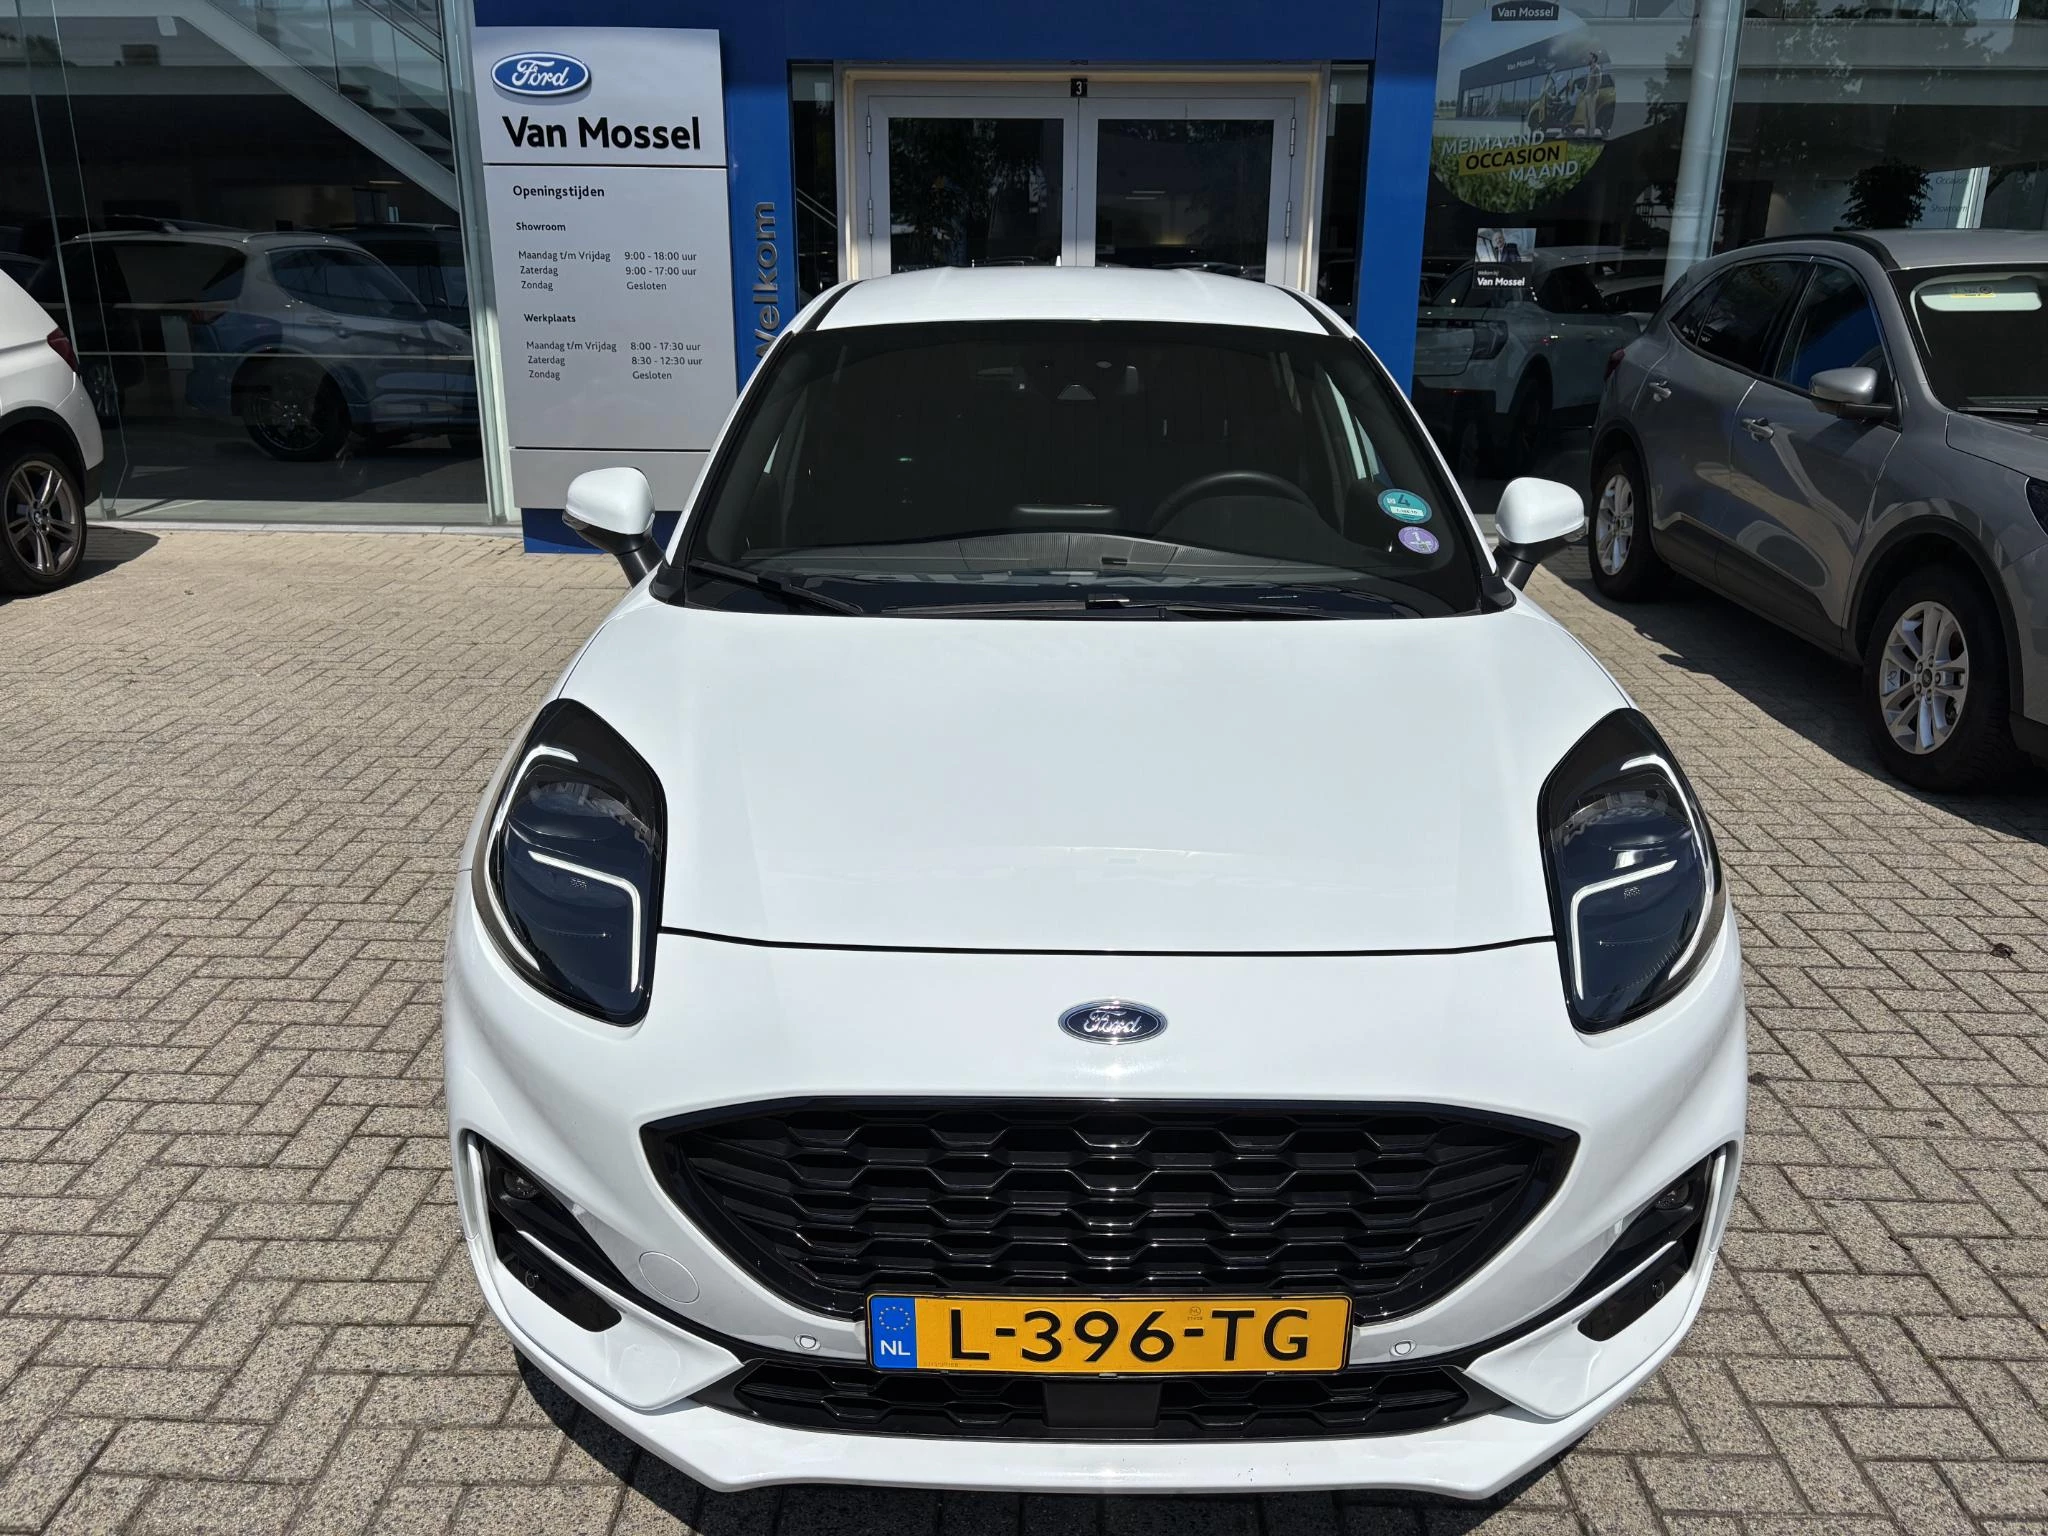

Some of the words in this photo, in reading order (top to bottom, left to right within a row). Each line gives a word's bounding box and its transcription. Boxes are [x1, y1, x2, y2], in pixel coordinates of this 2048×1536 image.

[1497, 7, 1516, 17] Van
[1519, 6, 1554, 17] Mossel
[511, 59, 570, 86] Ford
[1075, 80, 1083, 95] 3
[502, 115, 567, 148] Van
[578, 116, 700, 150] Mossel
[1442, 131, 1545, 156] MEIMAAND
[1465, 145, 1560, 170] OCCASION
[1508, 160, 1578, 182] MAAND
[512, 185, 605, 200] Openingstijden
[515, 221, 566, 232] Showroom
[518, 250, 558, 262] Maandag
[559, 251, 577, 260] t/m
[579, 251, 611, 262] Vrijdag
[624, 251, 645, 261] 9:00
[654, 252, 680, 261] 18:00
[681, 253, 697, 261] uur
[519, 265, 559, 277] Zaterdag
[625, 267, 646, 276] 9:00
[655, 267, 680, 276] 17:00
[681, 268, 697, 276] uur
[521, 280, 553, 291] Zondag
[626, 281, 667, 290] Gesloten
[1477, 277, 1493, 286] Van
[1495, 277, 1525, 286] Mossel
[523, 313, 576, 325] Werkplaats
[526, 341, 565, 352] Maandag
[566, 341, 583, 350] t/m
[585, 341, 617, 353] Vrijdag
[630, 342, 651, 351] 8:00
[659, 342, 684, 351] 17:30
[685, 343, 701, 351] uur
[527, 355, 565, 366] Zaterdag
[631, 356, 652, 365] 8:30
[660, 356, 685, 366] 12:30
[687, 358, 702, 366] uur
[528, 370, 560, 380] Zondag
[632, 371, 672, 380] Gesloten
[1398, 494, 1410, 506] 4
[1083, 1010, 1142, 1034] Ford
[950, 1308, 1309, 1362] L-396-TG
[879, 1339, 911, 1356] NL
